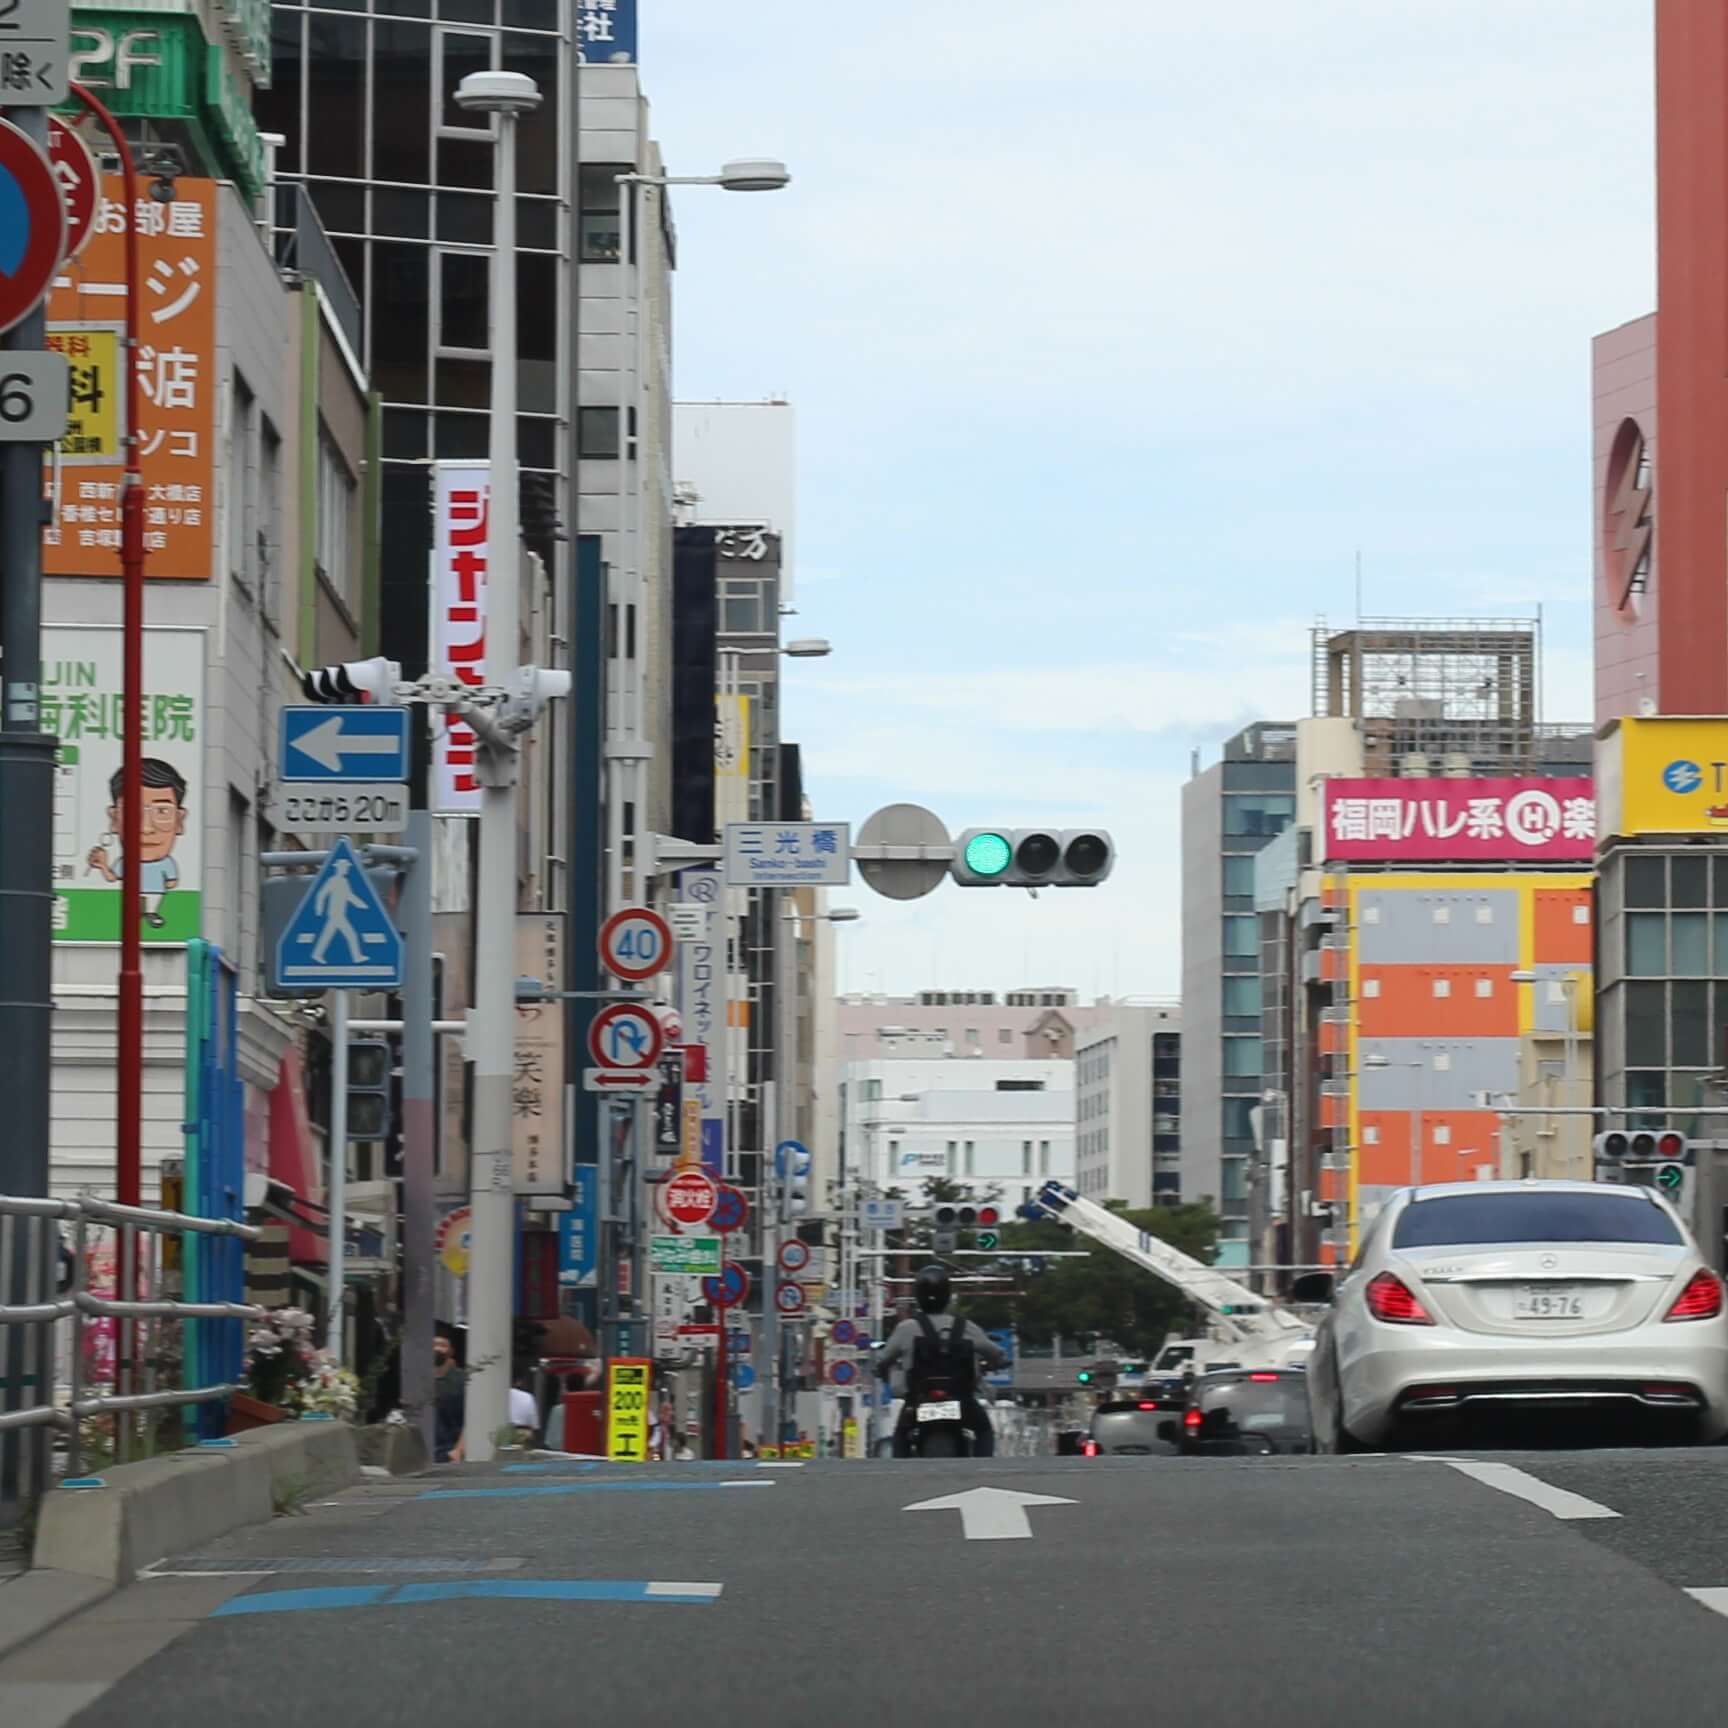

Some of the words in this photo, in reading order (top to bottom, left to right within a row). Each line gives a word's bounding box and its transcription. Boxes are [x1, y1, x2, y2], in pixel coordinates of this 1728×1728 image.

[1332, 796, 1504, 842] 福岡ハレ系
[737, 829, 839, 855] 三光橋
[616, 928, 657, 961] 40
